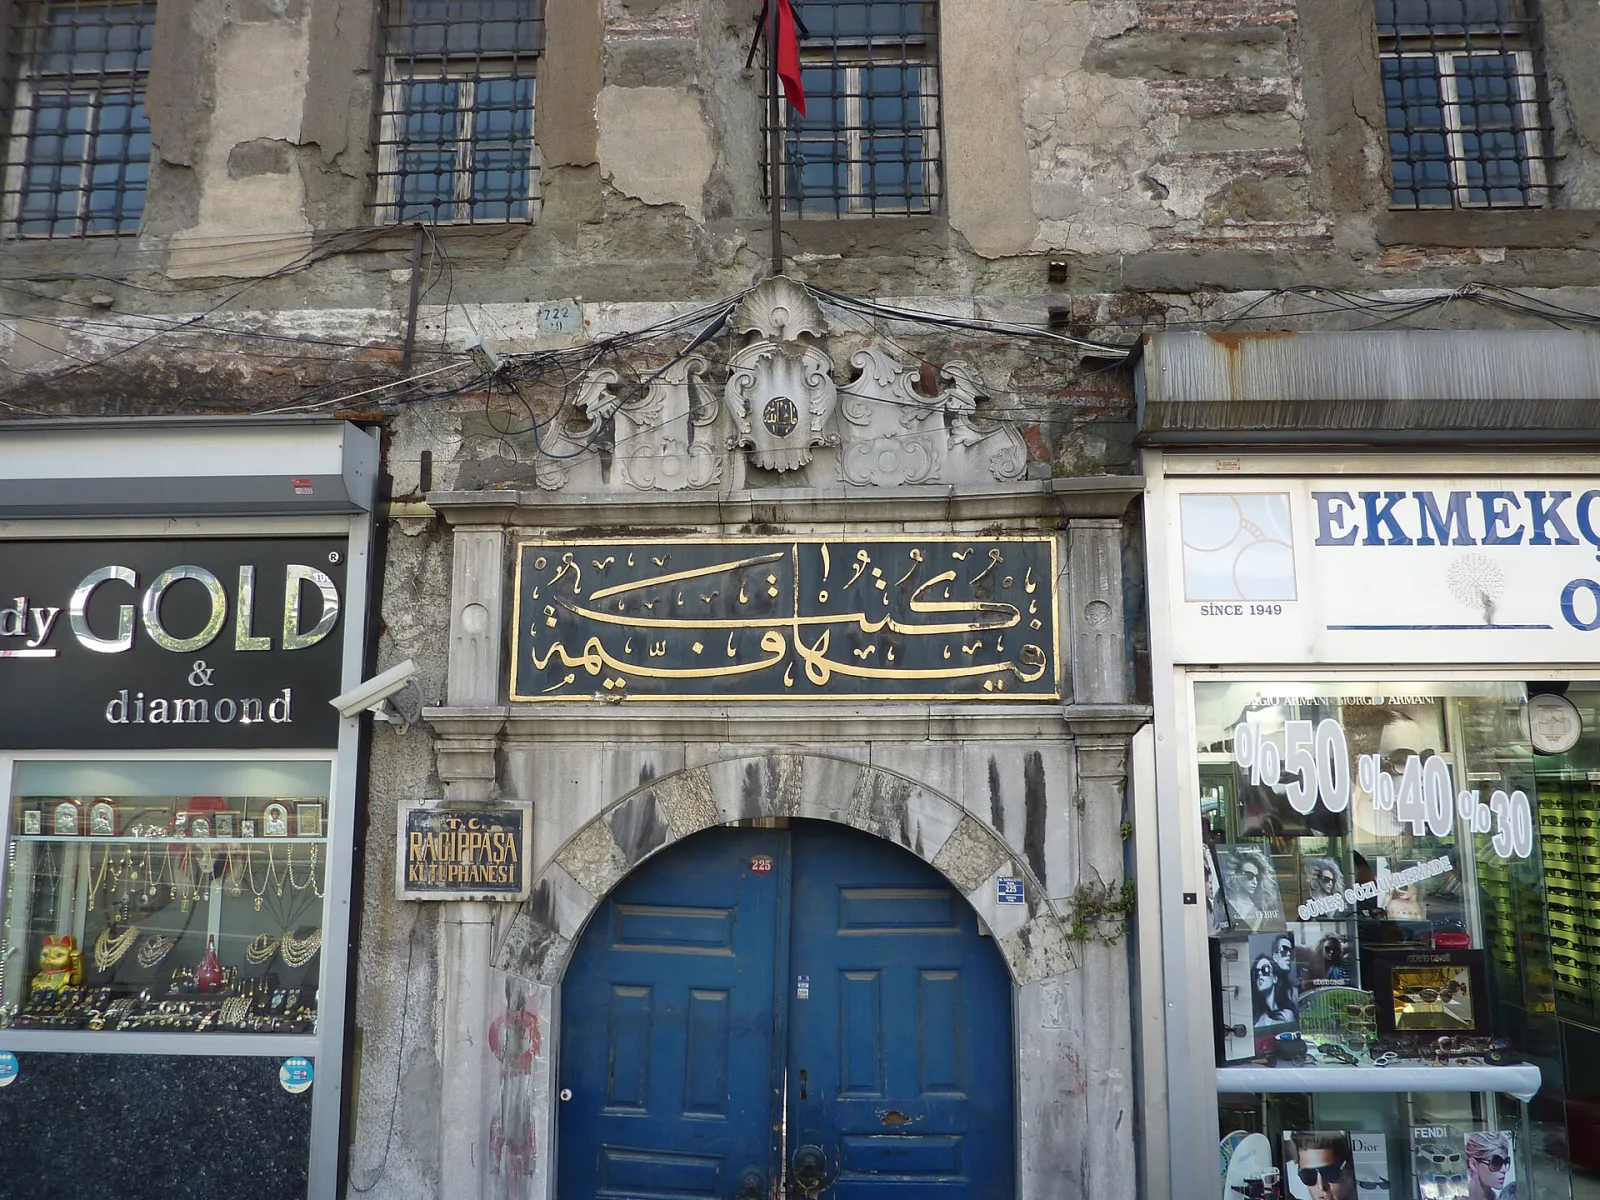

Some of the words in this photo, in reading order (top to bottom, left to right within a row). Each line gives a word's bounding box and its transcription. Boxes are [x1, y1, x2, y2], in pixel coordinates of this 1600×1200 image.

[544, 307, 569, 320] 722
[69, 564, 340, 652] GOLD
[1249, 604, 1282, 616] 1949
[188, 660, 215, 687] &
[106, 688, 293, 724] diamond
[1387, 695, 1436, 705] ARMANI
[1233, 718, 1350, 813] %50
[1358, 753, 1454, 837] %40
[1458, 790, 1533, 859] %30
[751, 859, 771, 871] 225
[1297, 893, 1346, 922] GÜNEŞ
[1352, 1139, 1379, 1152] Dior
[1414, 1127, 1448, 1138] FENDI
